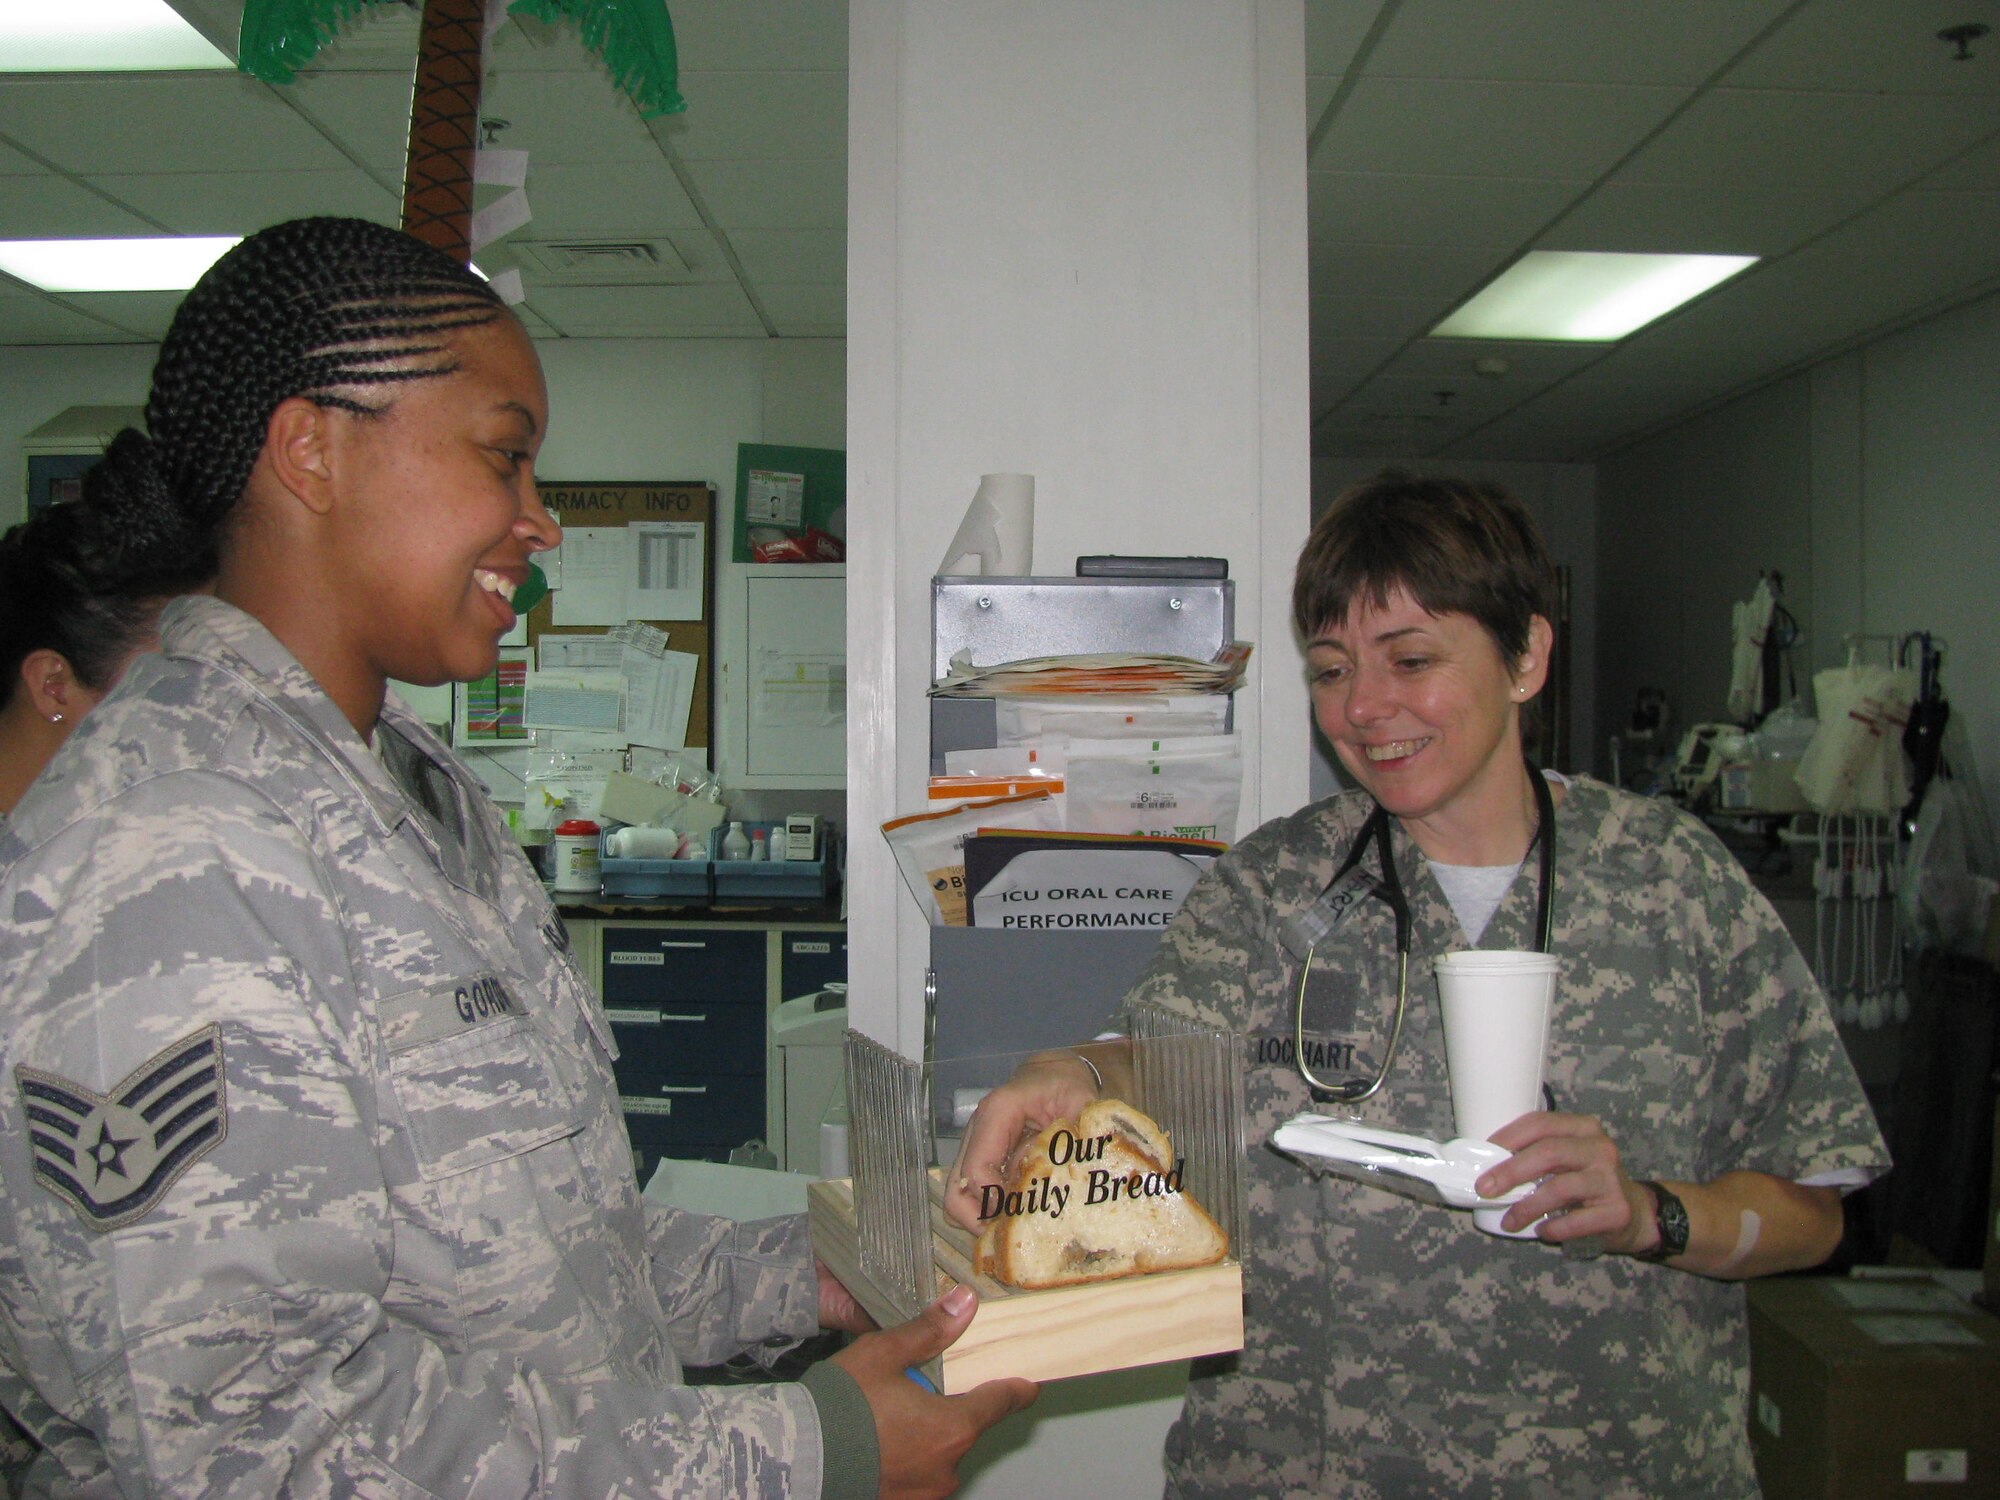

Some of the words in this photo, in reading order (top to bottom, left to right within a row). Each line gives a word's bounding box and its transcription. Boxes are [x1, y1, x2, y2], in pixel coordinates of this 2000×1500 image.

[540, 491, 627, 511] ARMACY
[645, 492, 691, 511] INFO
[1141, 792, 1149, 803] 6
[1151, 829, 1206, 840] Biel
[1002, 890, 1039, 903] ICU
[1047, 888, 1108, 900] ORAL
[1115, 888, 1174, 900] CARE
[1002, 912, 1174, 929] PERFORMANCE
[1048, 1129, 1113, 1166] Our
[977, 1176, 1070, 1220] Daily
[1084, 1158, 1185, 1206] Bread
